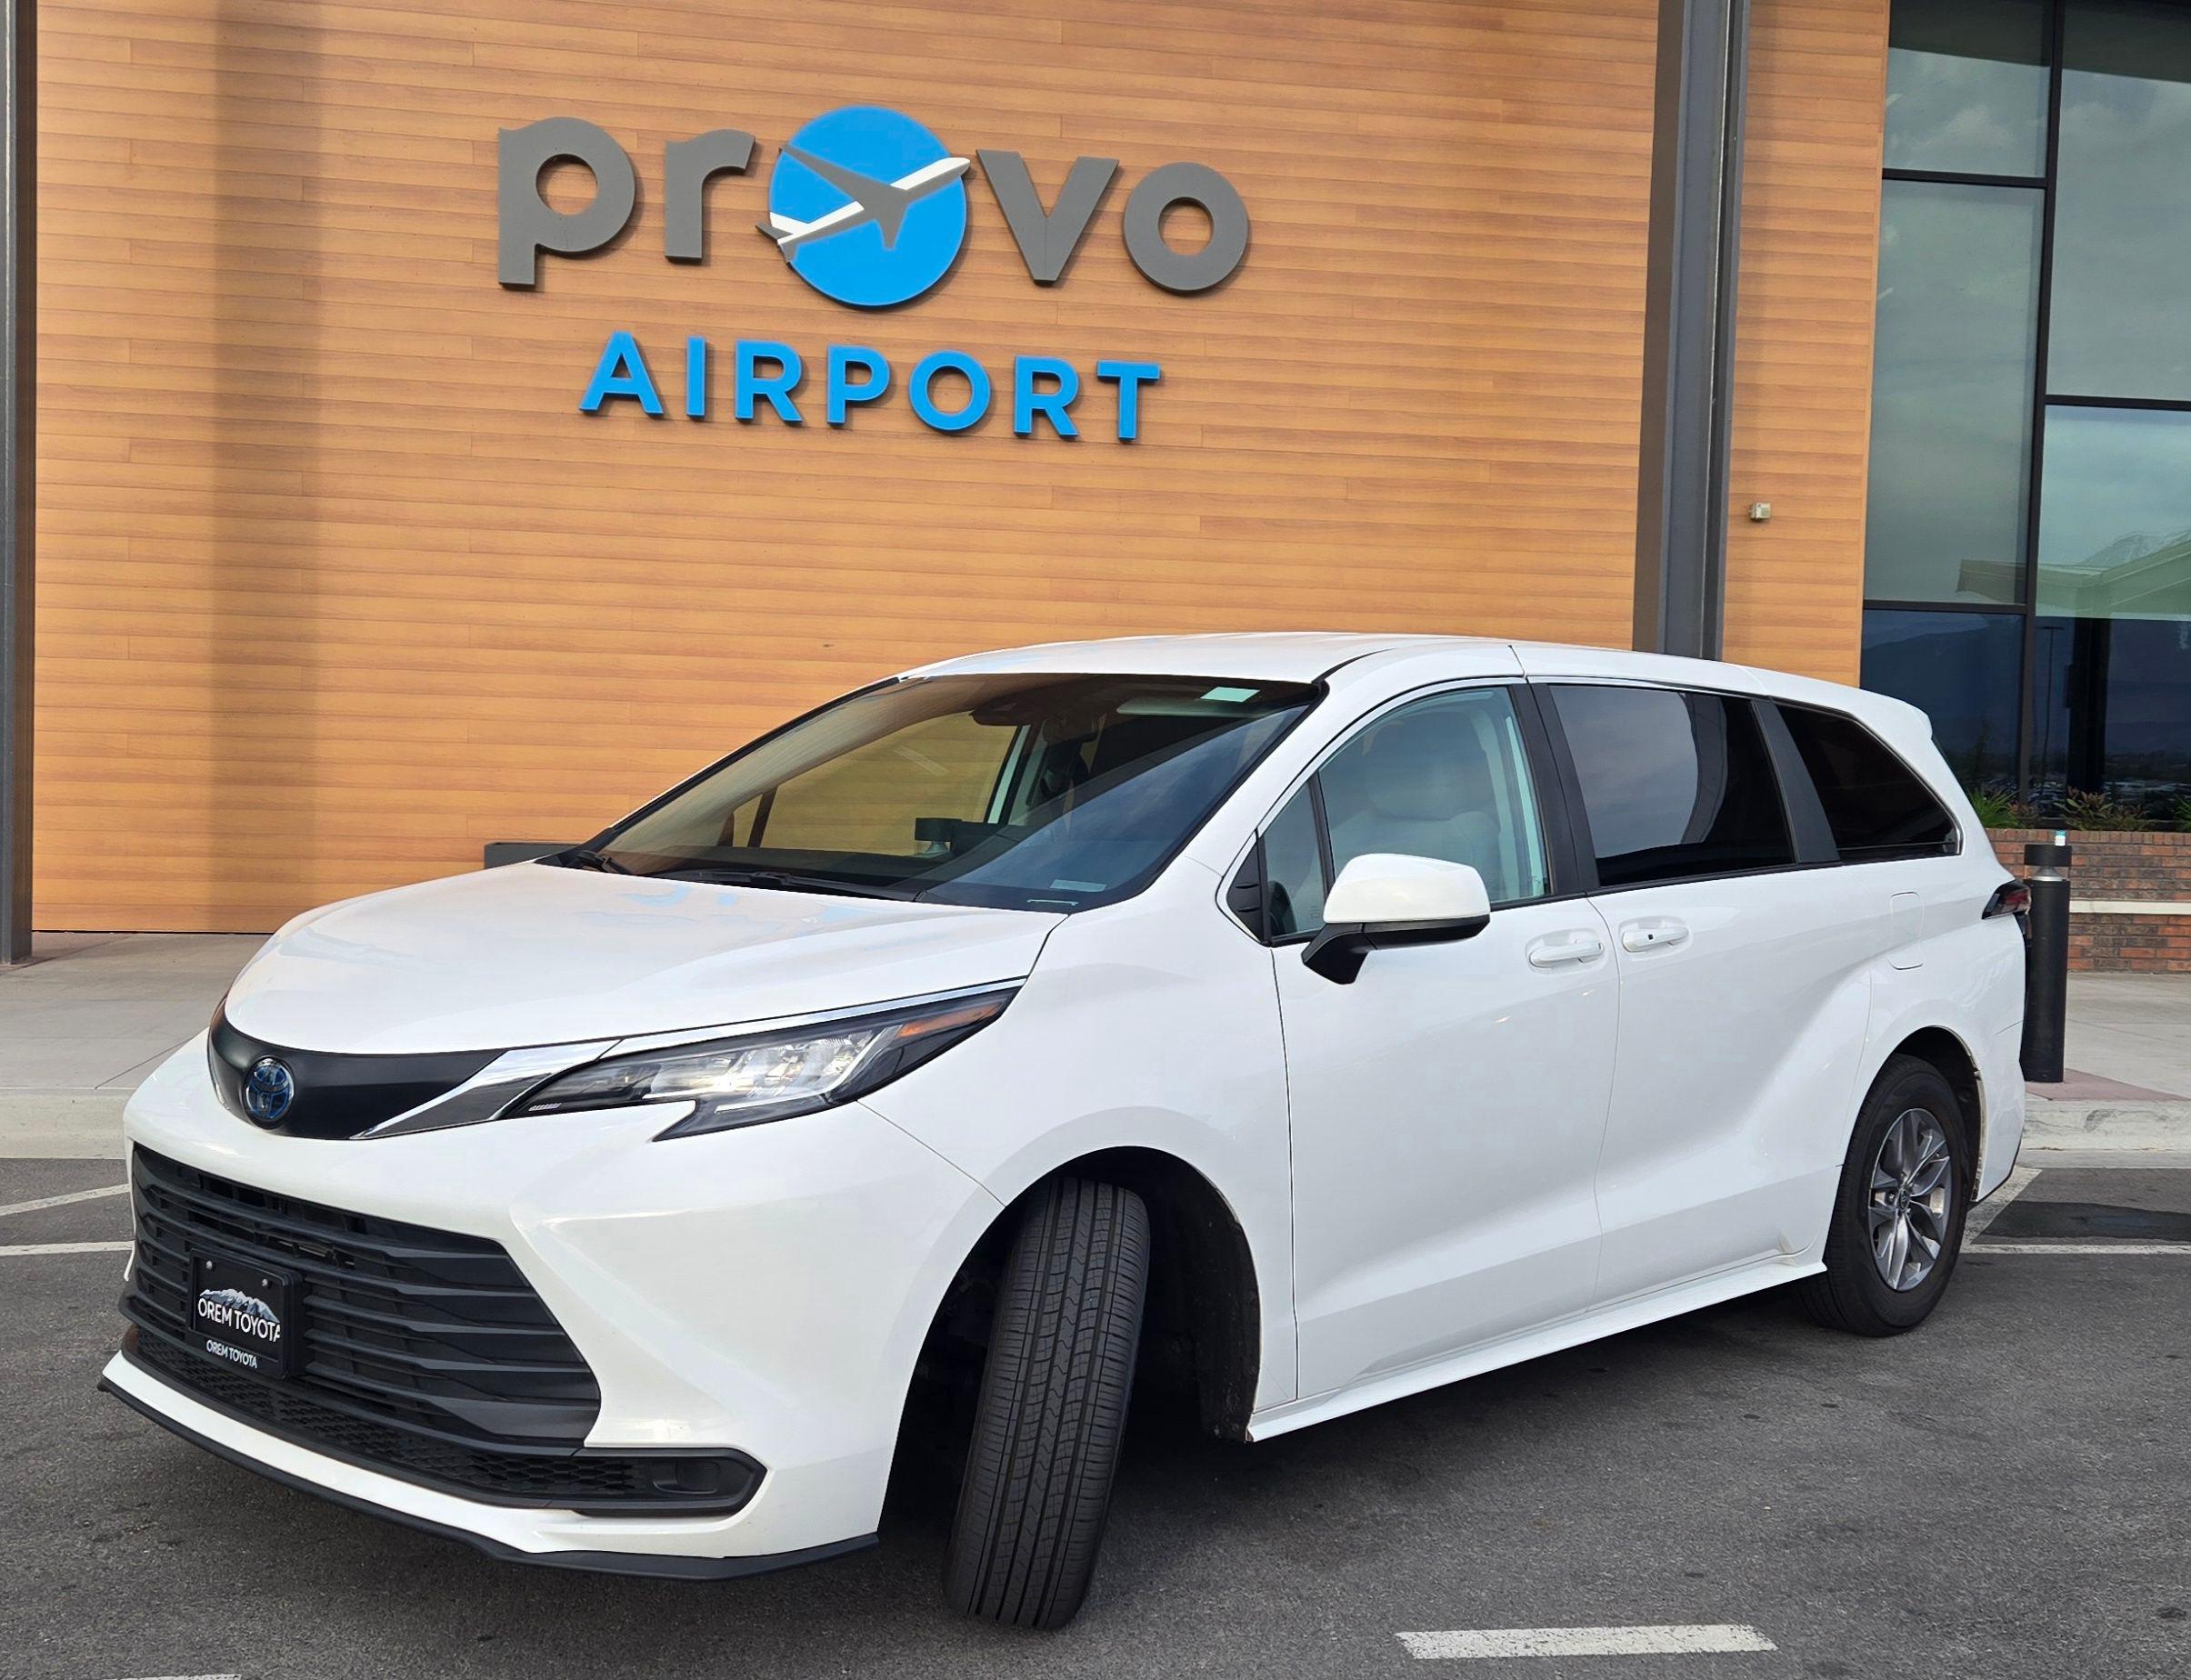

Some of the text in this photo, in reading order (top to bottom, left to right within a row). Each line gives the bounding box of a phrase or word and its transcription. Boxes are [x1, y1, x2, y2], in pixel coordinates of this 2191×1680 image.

[579, 331, 1162, 442] AIRPORT
[198, 1298, 233, 1327] OREM
[206, 1340, 258, 1369] OREM TOYOTA
